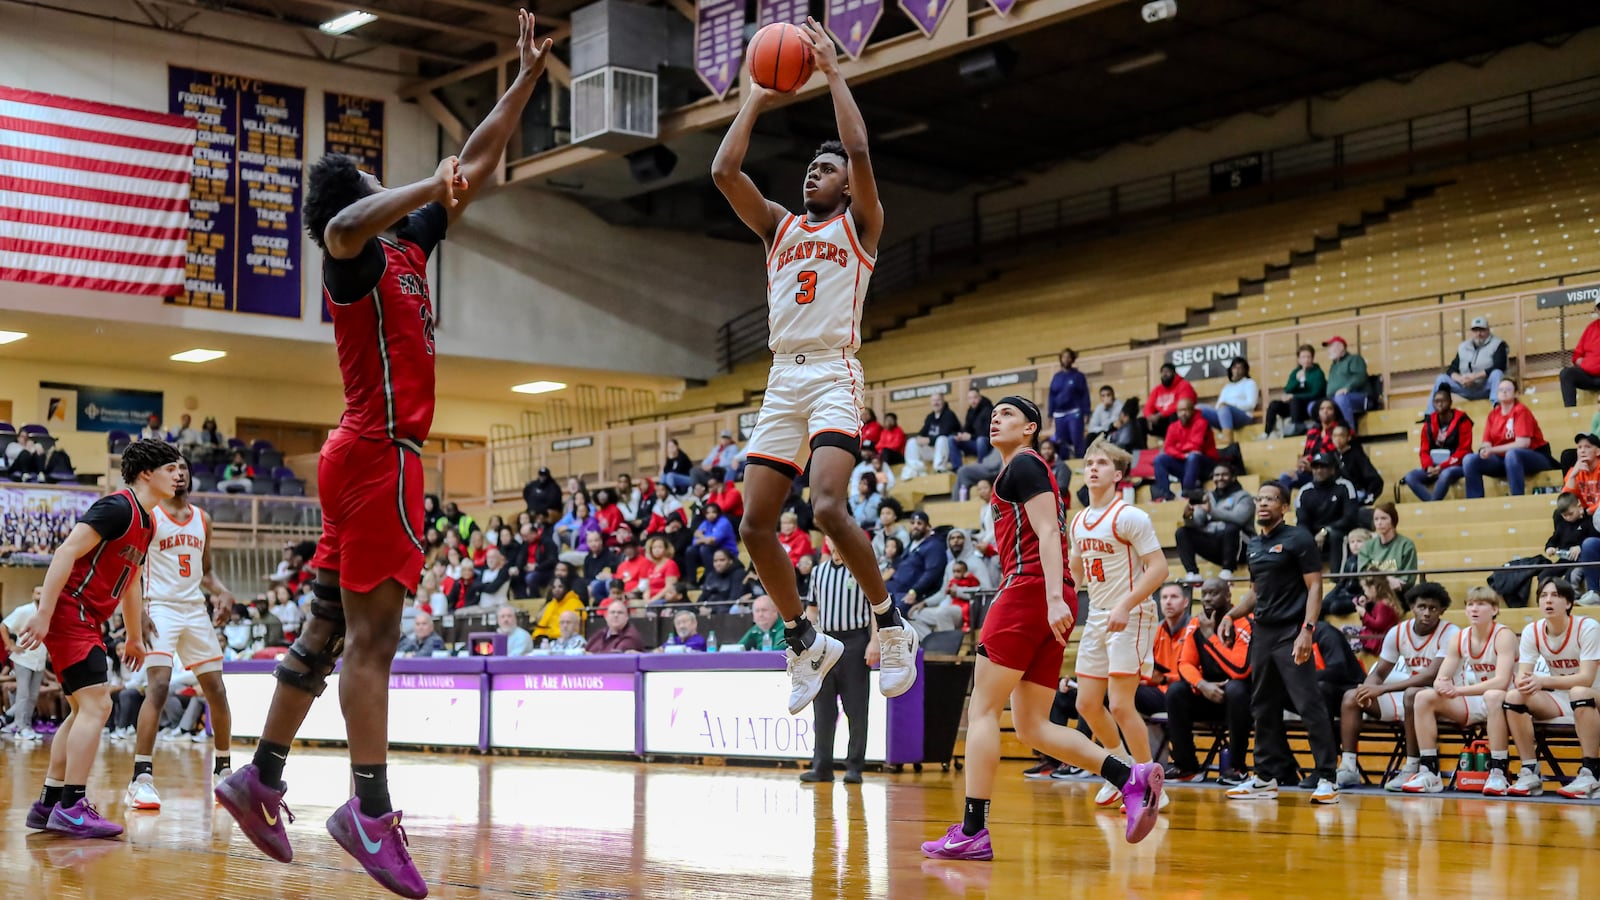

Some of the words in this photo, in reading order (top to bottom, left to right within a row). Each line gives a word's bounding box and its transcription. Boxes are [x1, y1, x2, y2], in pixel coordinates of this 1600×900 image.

[242, 118, 300, 138] VOLLEYBALL
[1231, 170, 1241, 187] 5
[190, 199, 220, 213] ENNIS
[777, 241, 848, 272] BEAVERS
[795, 270, 818, 305] 3
[1567, 288, 1600, 302] VISITO
[1172, 341, 1241, 366] SECTION
[1202, 362, 1210, 378] 1
[178, 553, 192, 577] 5
[1085, 558, 1106, 583] 14
[110, 564, 131, 600] 1
[561, 674, 604, 689] AVIATORS
[699, 710, 816, 752] AVIATOR
